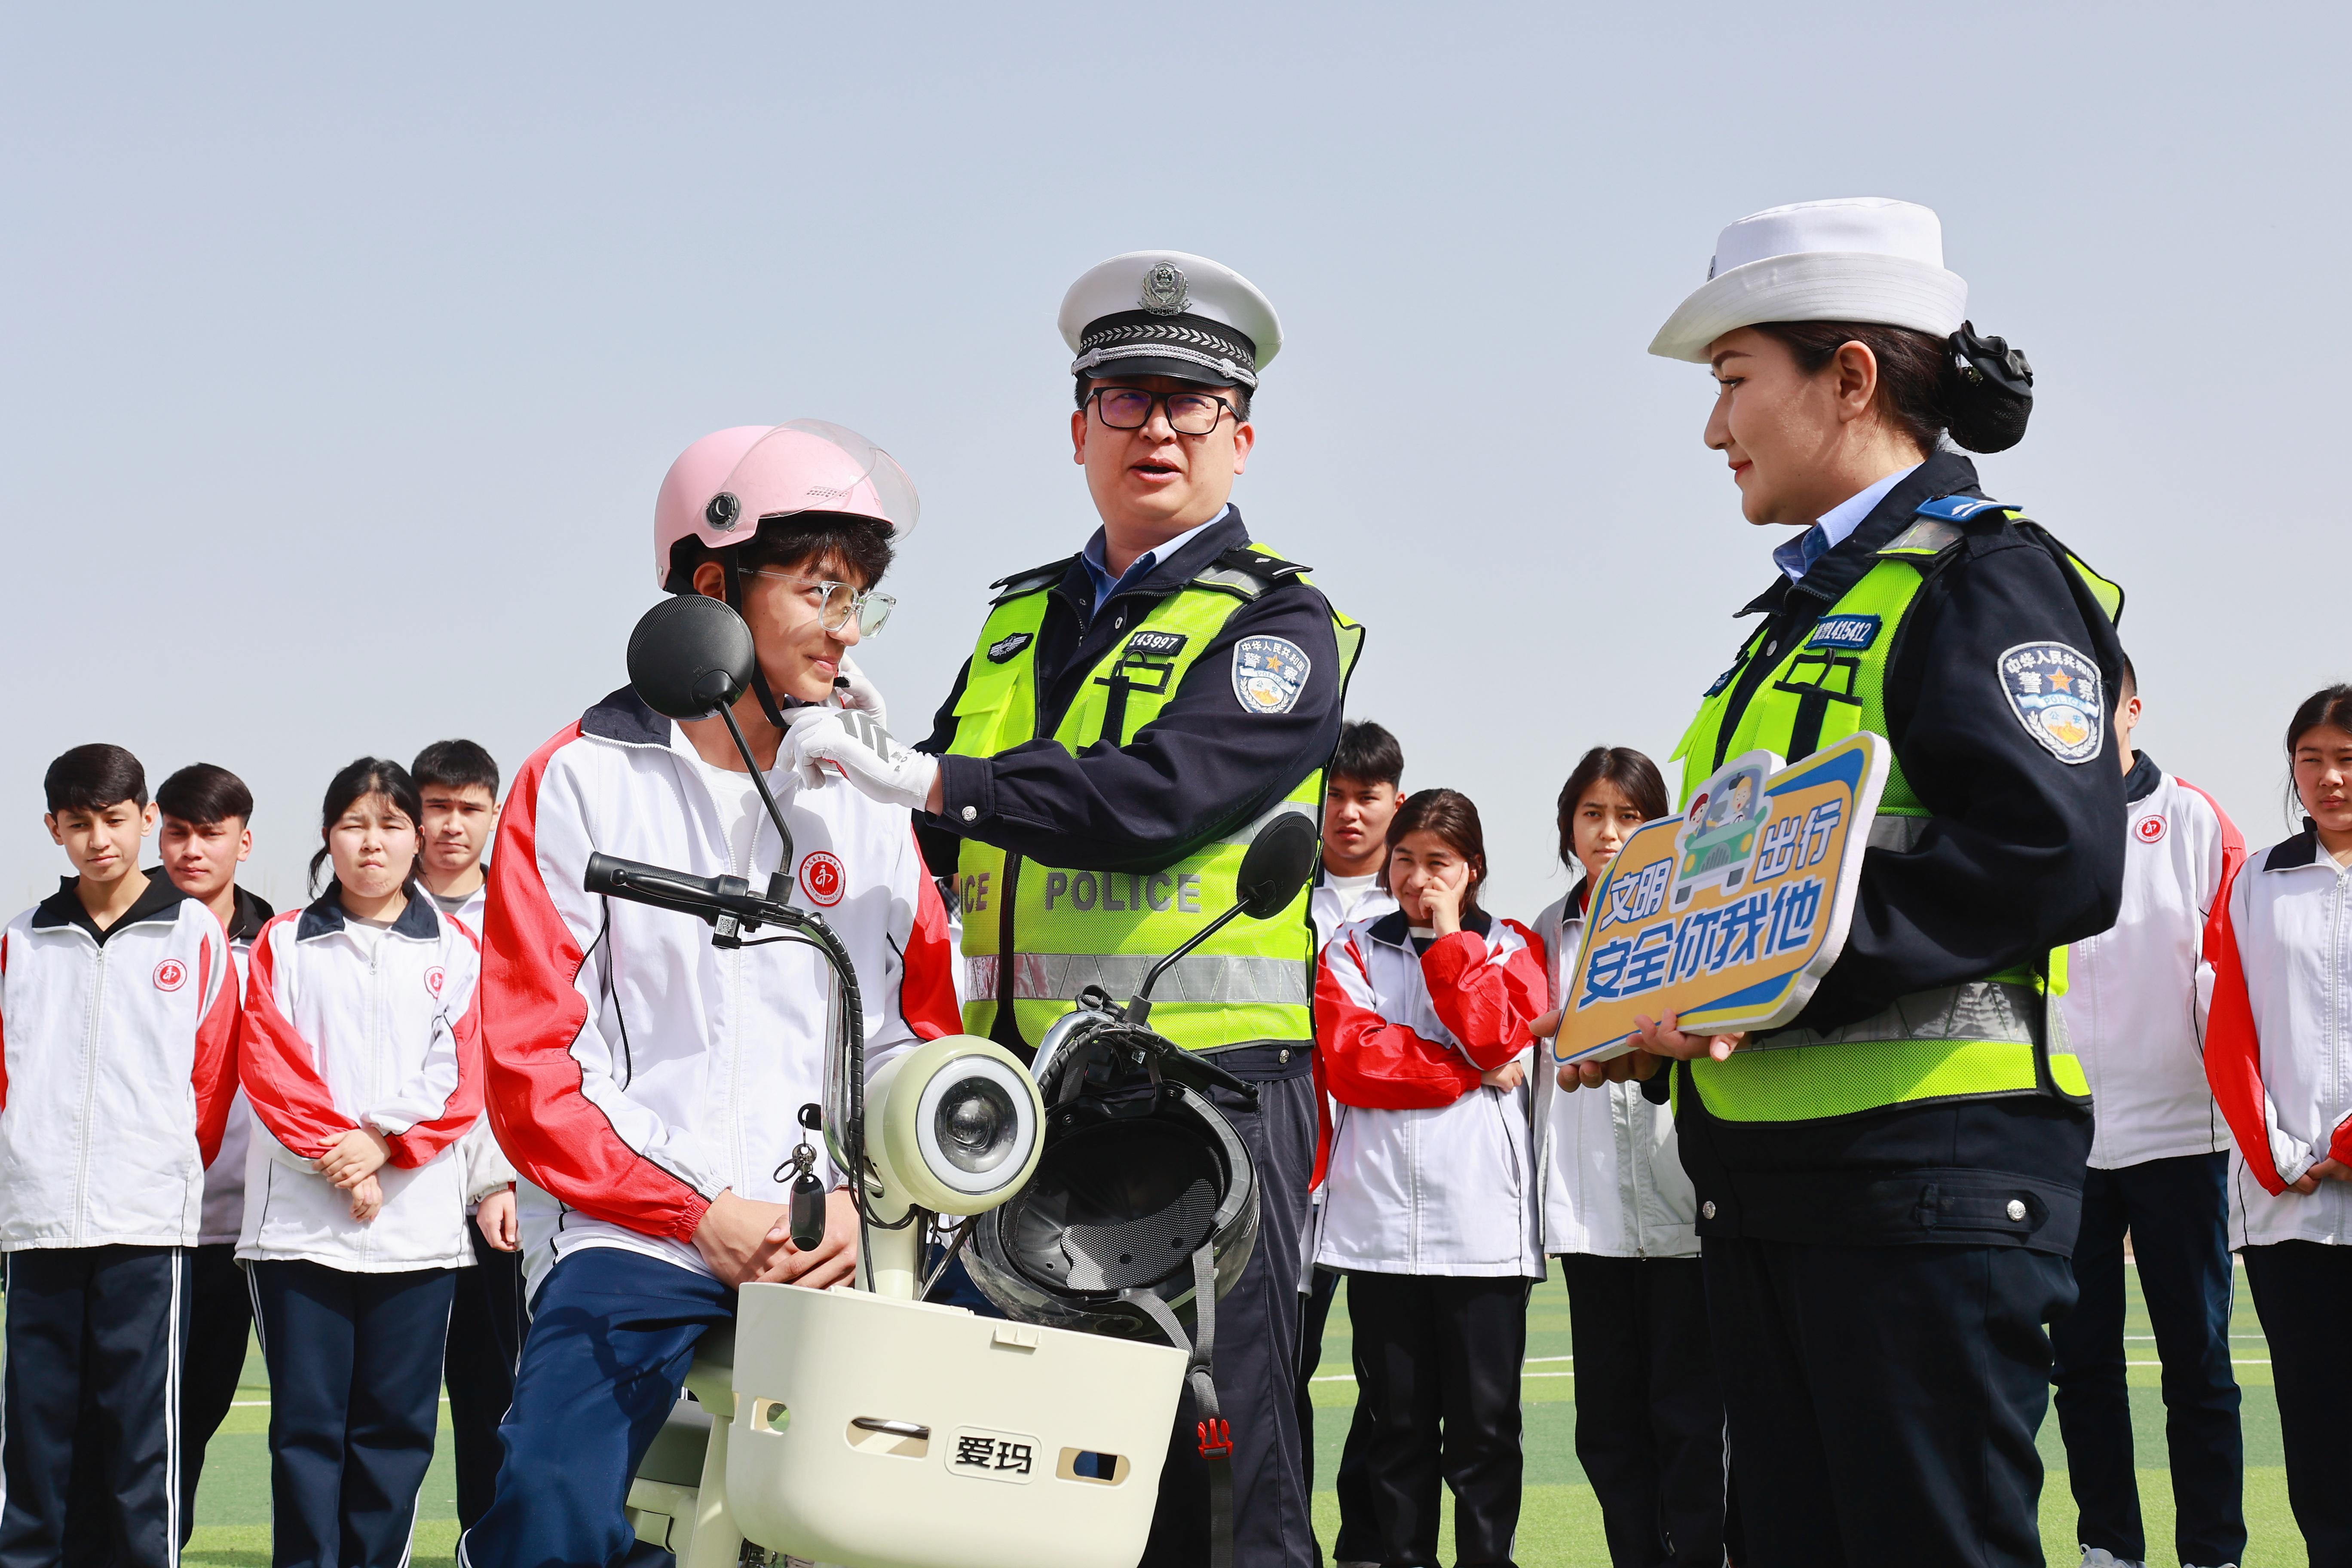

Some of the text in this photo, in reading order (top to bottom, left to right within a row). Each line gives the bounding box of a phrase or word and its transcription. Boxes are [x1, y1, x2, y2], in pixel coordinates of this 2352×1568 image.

[1129, 634, 1179, 649] 143997
[1241, 640, 1305, 672] 中华人民共和国
[1257, 671, 1283, 685] POLICE
[2006, 650, 2096, 685] 中华人民共和国
[2044, 695, 2083, 707] POLICE
[1600, 798, 1843, 932] 文明 出行
[1045, 872, 1200, 913] POLICE
[1577, 879, 1824, 1009] 安全你我他
[956, 1436, 1032, 1474] 爱玛
